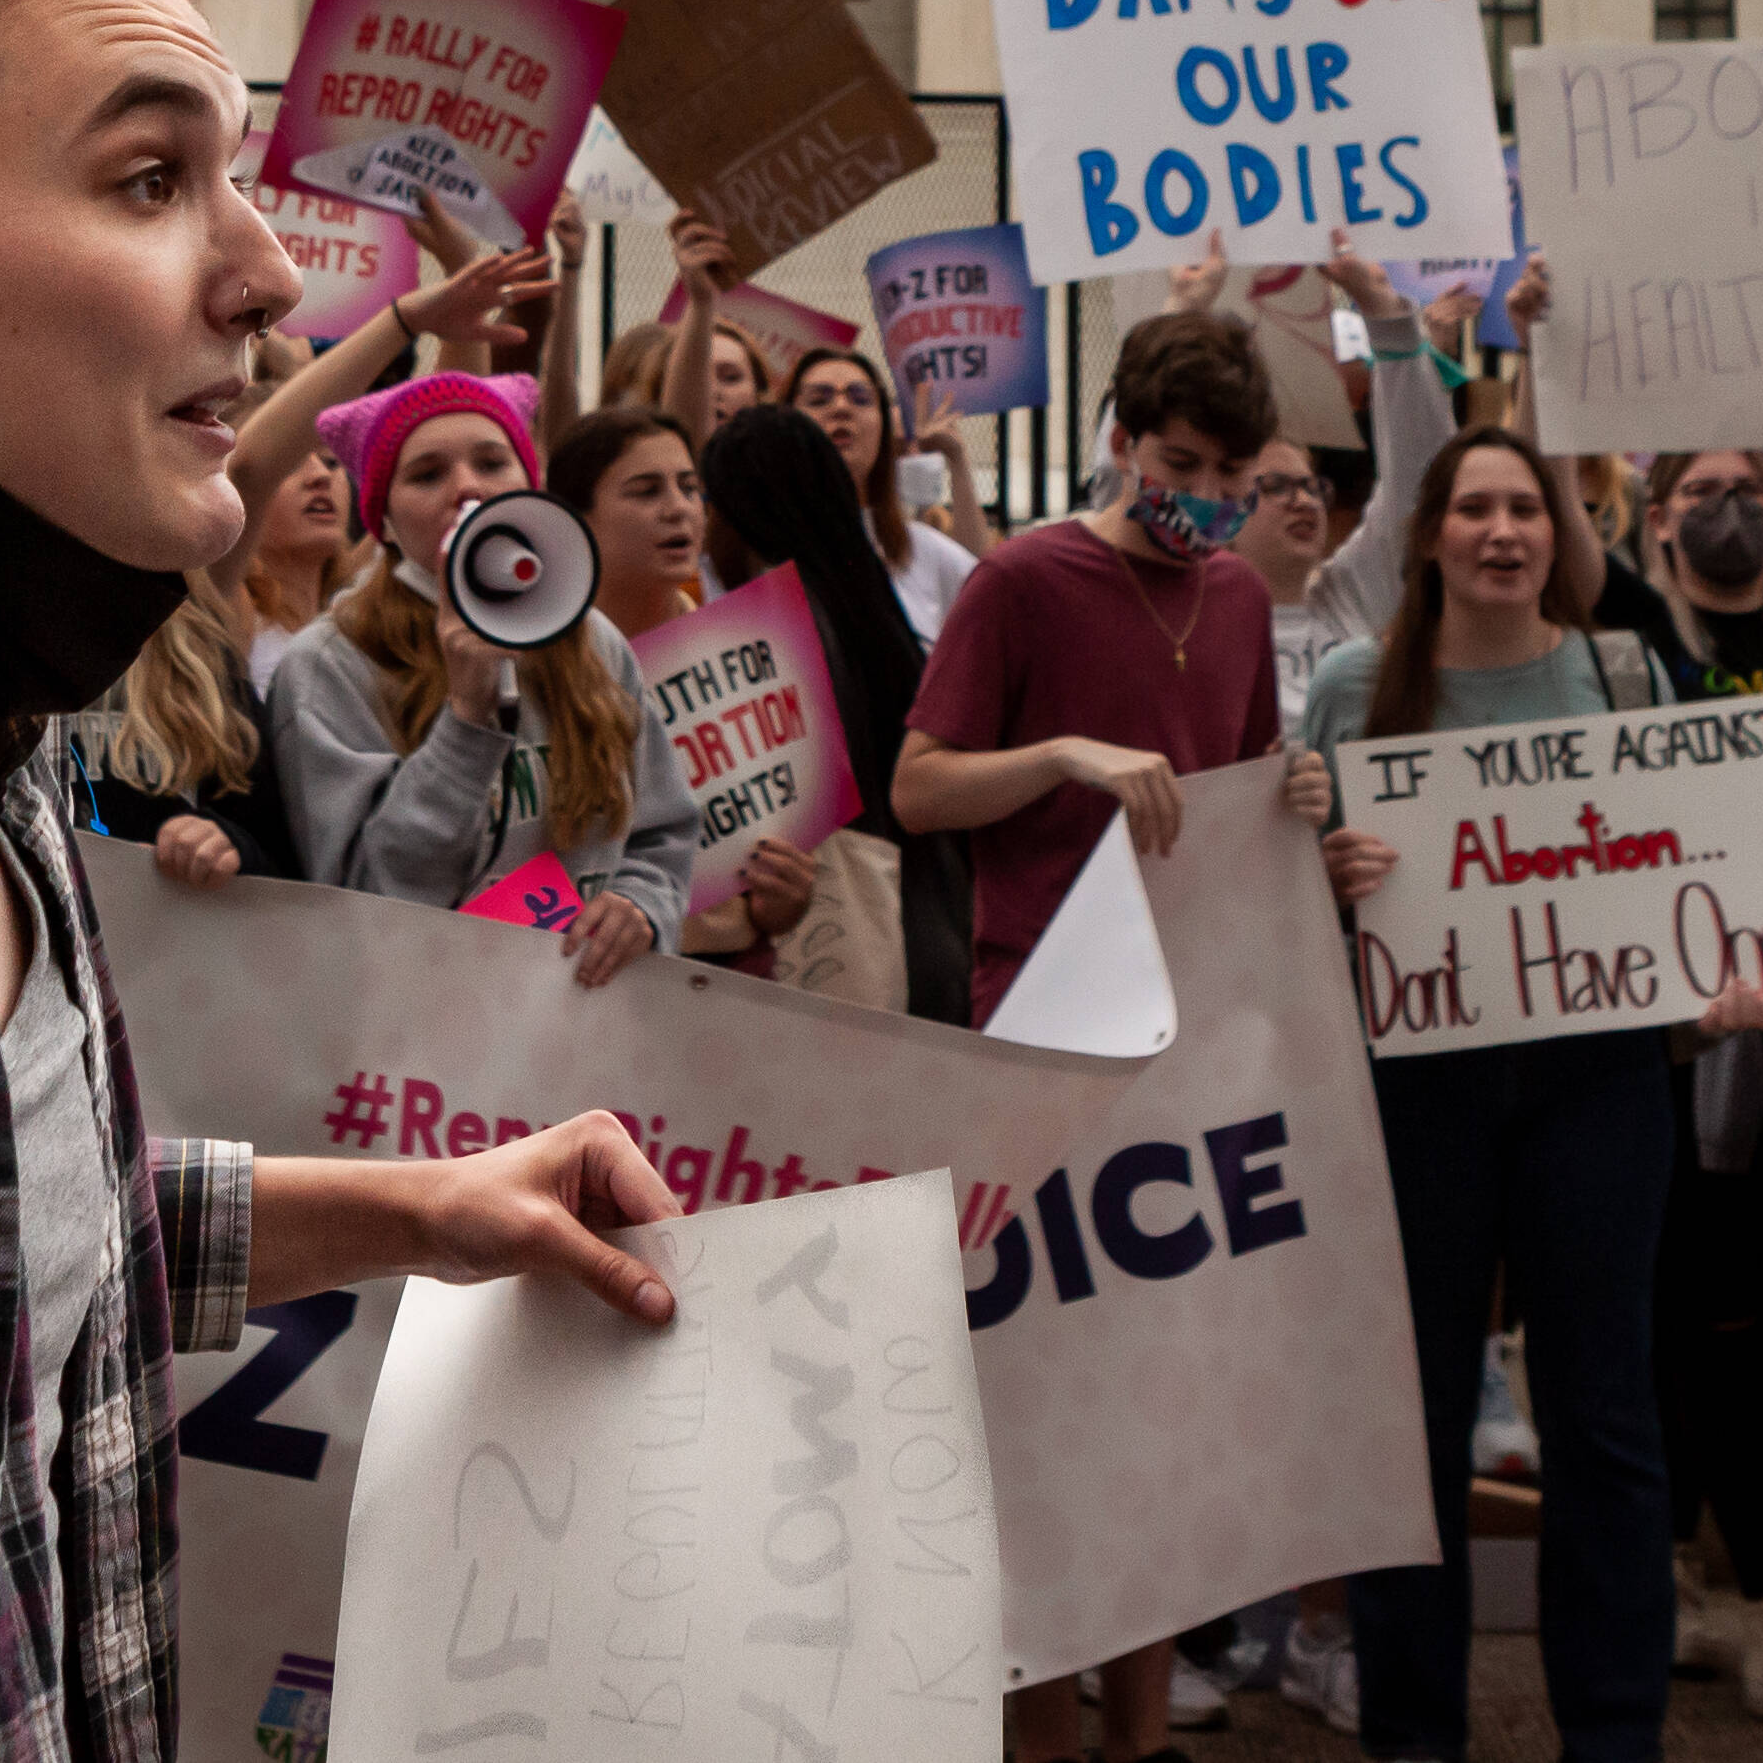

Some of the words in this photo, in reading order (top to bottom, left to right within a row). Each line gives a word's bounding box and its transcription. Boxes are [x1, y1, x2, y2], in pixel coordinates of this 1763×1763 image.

[386, 15, 491, 75] RALLY
[488, 45, 551, 105] FOR
[1176, 42, 1351, 126] OUR
[317, 71, 423, 125] REPRO
[423, 87, 550, 169] RIGHTS
[1078, 136, 1430, 257] BODIES
[934, 263, 989, 297] FOR
[719, 639, 778, 693] FOR
[700, 759, 799, 849] IGHTS!
[1367, 748, 1433, 803] IF
[1509, 900, 1660, 1017] Have
